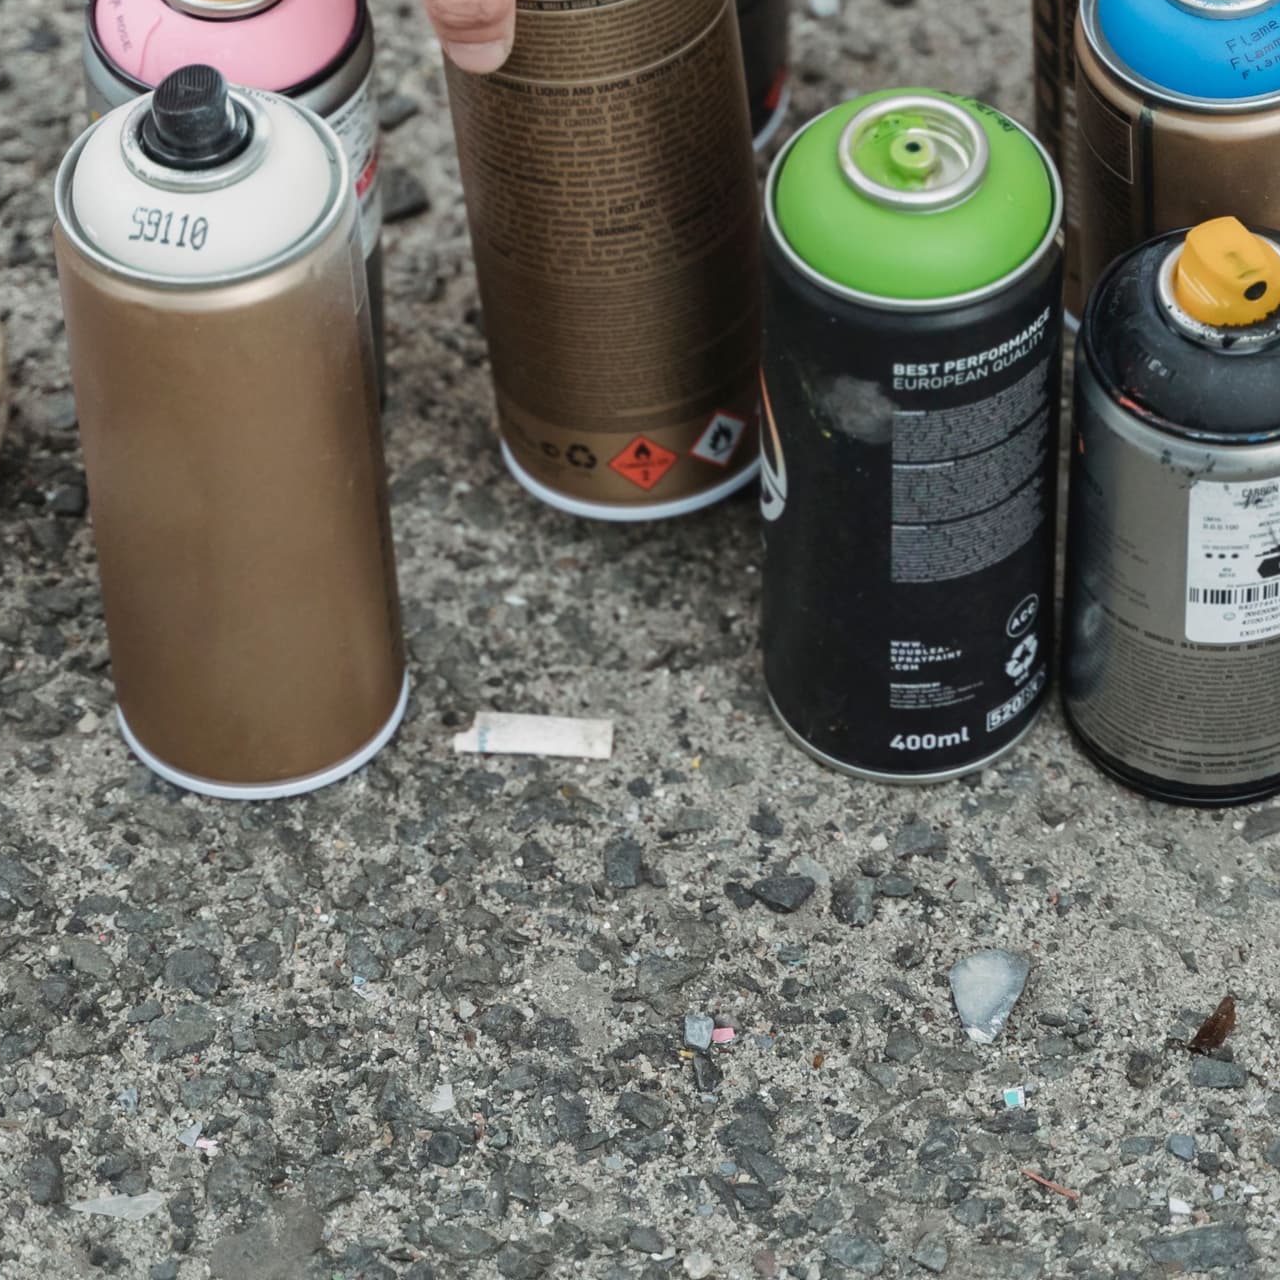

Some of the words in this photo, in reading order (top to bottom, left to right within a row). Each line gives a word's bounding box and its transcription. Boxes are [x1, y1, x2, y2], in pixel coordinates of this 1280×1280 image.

[1225, 20, 1280, 54] Flame
[535, 85, 569, 98] LIQUID
[572, 86, 594, 97] AND
[609, 201, 636, 215] FIRST
[893, 362, 940, 377] BEST
[943, 305, 1051, 373] PERFORMANCE
[893, 365, 989, 390] EUROPEAN
[992, 327, 1046, 372] QUALITY
[1242, 482, 1279, 498] CARBON
[1011, 601, 1036, 631] ACC
[890, 646, 950, 656] DOUBLEA-
[890, 650, 962, 663] SPRAYPAINT
[889, 726, 970, 751] 400ml
